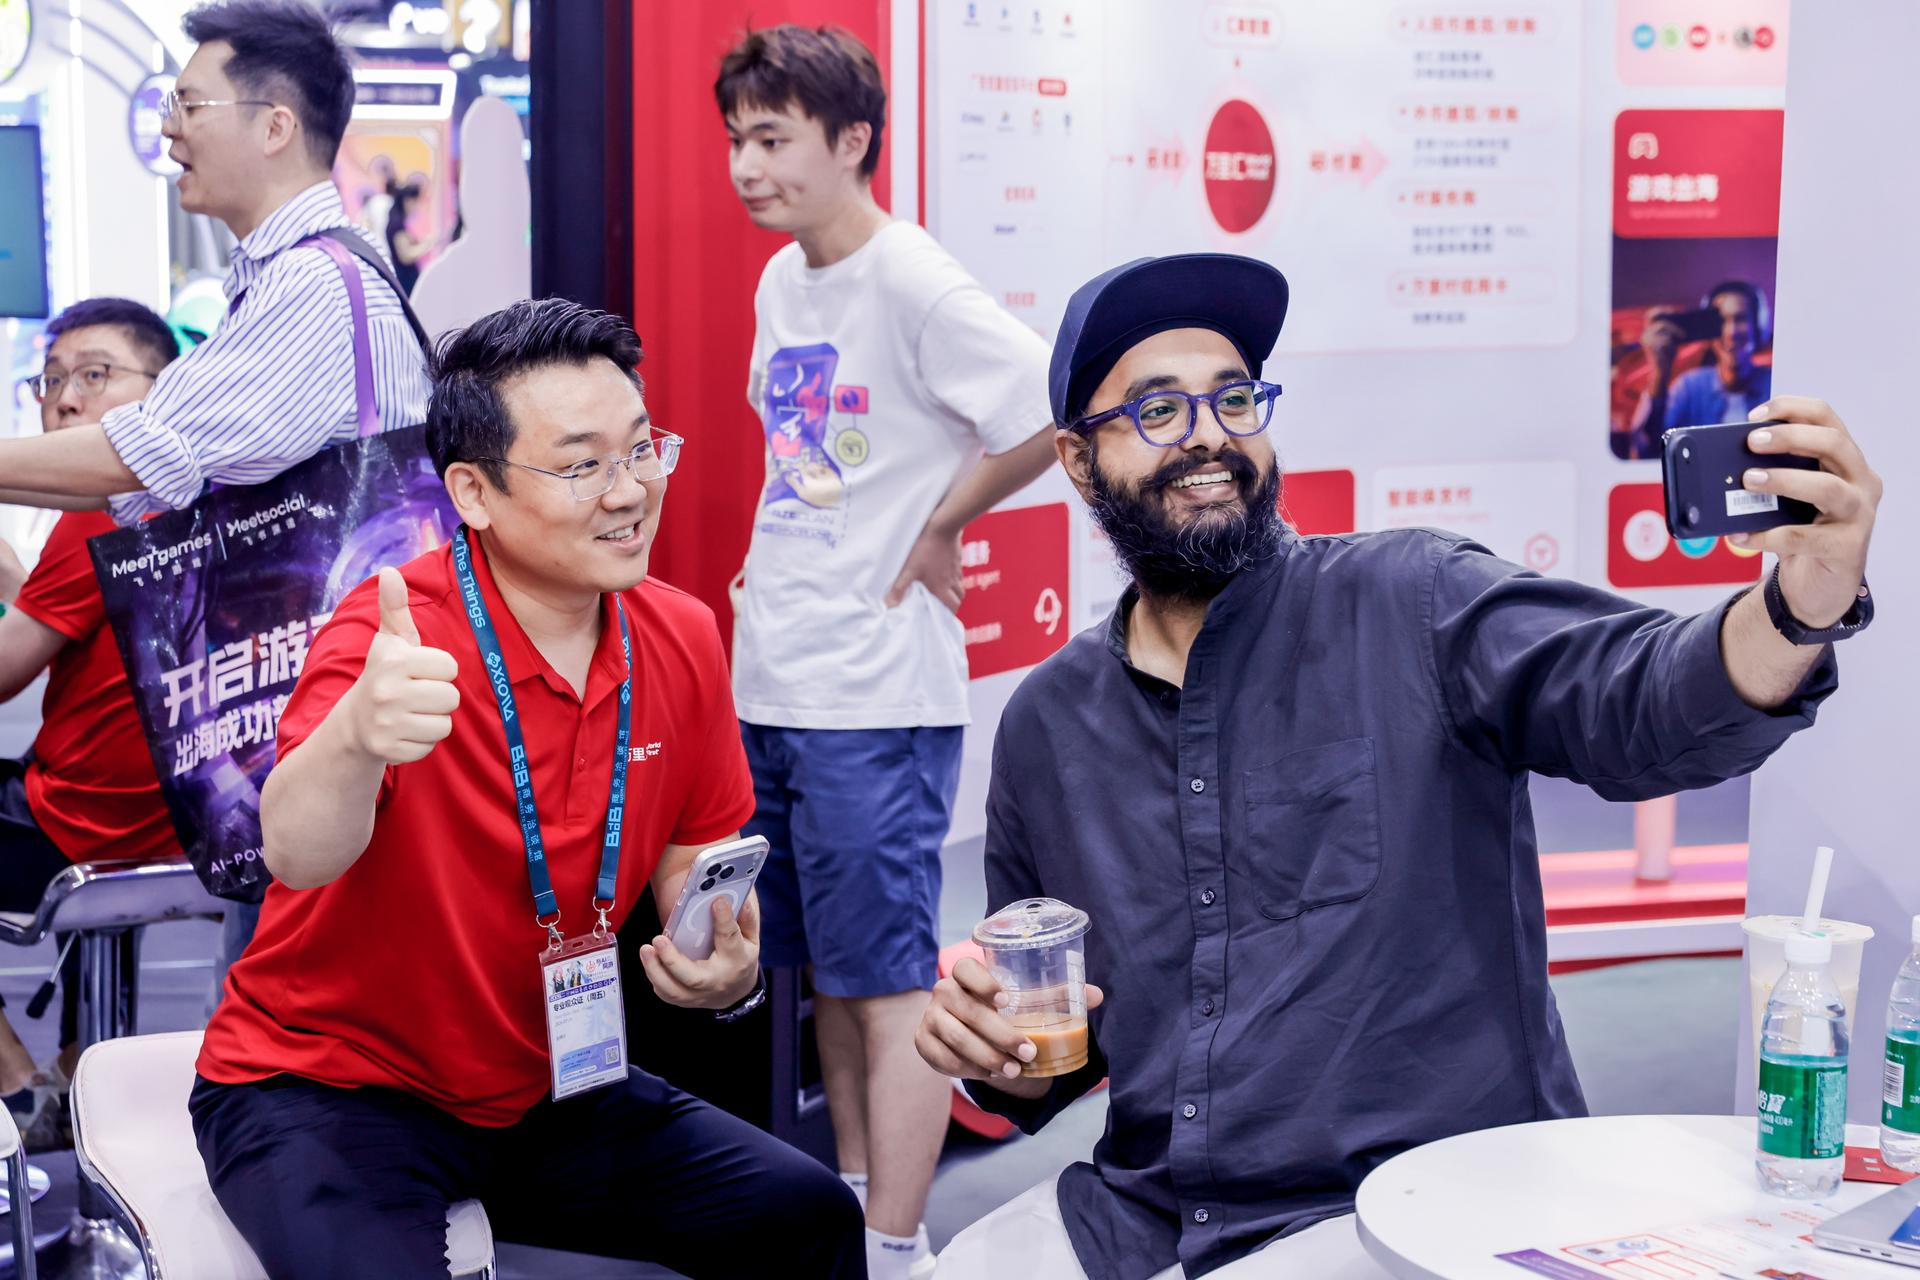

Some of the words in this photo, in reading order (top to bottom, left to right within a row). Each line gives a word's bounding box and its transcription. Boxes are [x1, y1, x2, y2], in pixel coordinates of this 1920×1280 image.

[455, 542, 468, 572] The
[462, 570, 486, 629] Things
[160, 611, 333, 728] 开启游
